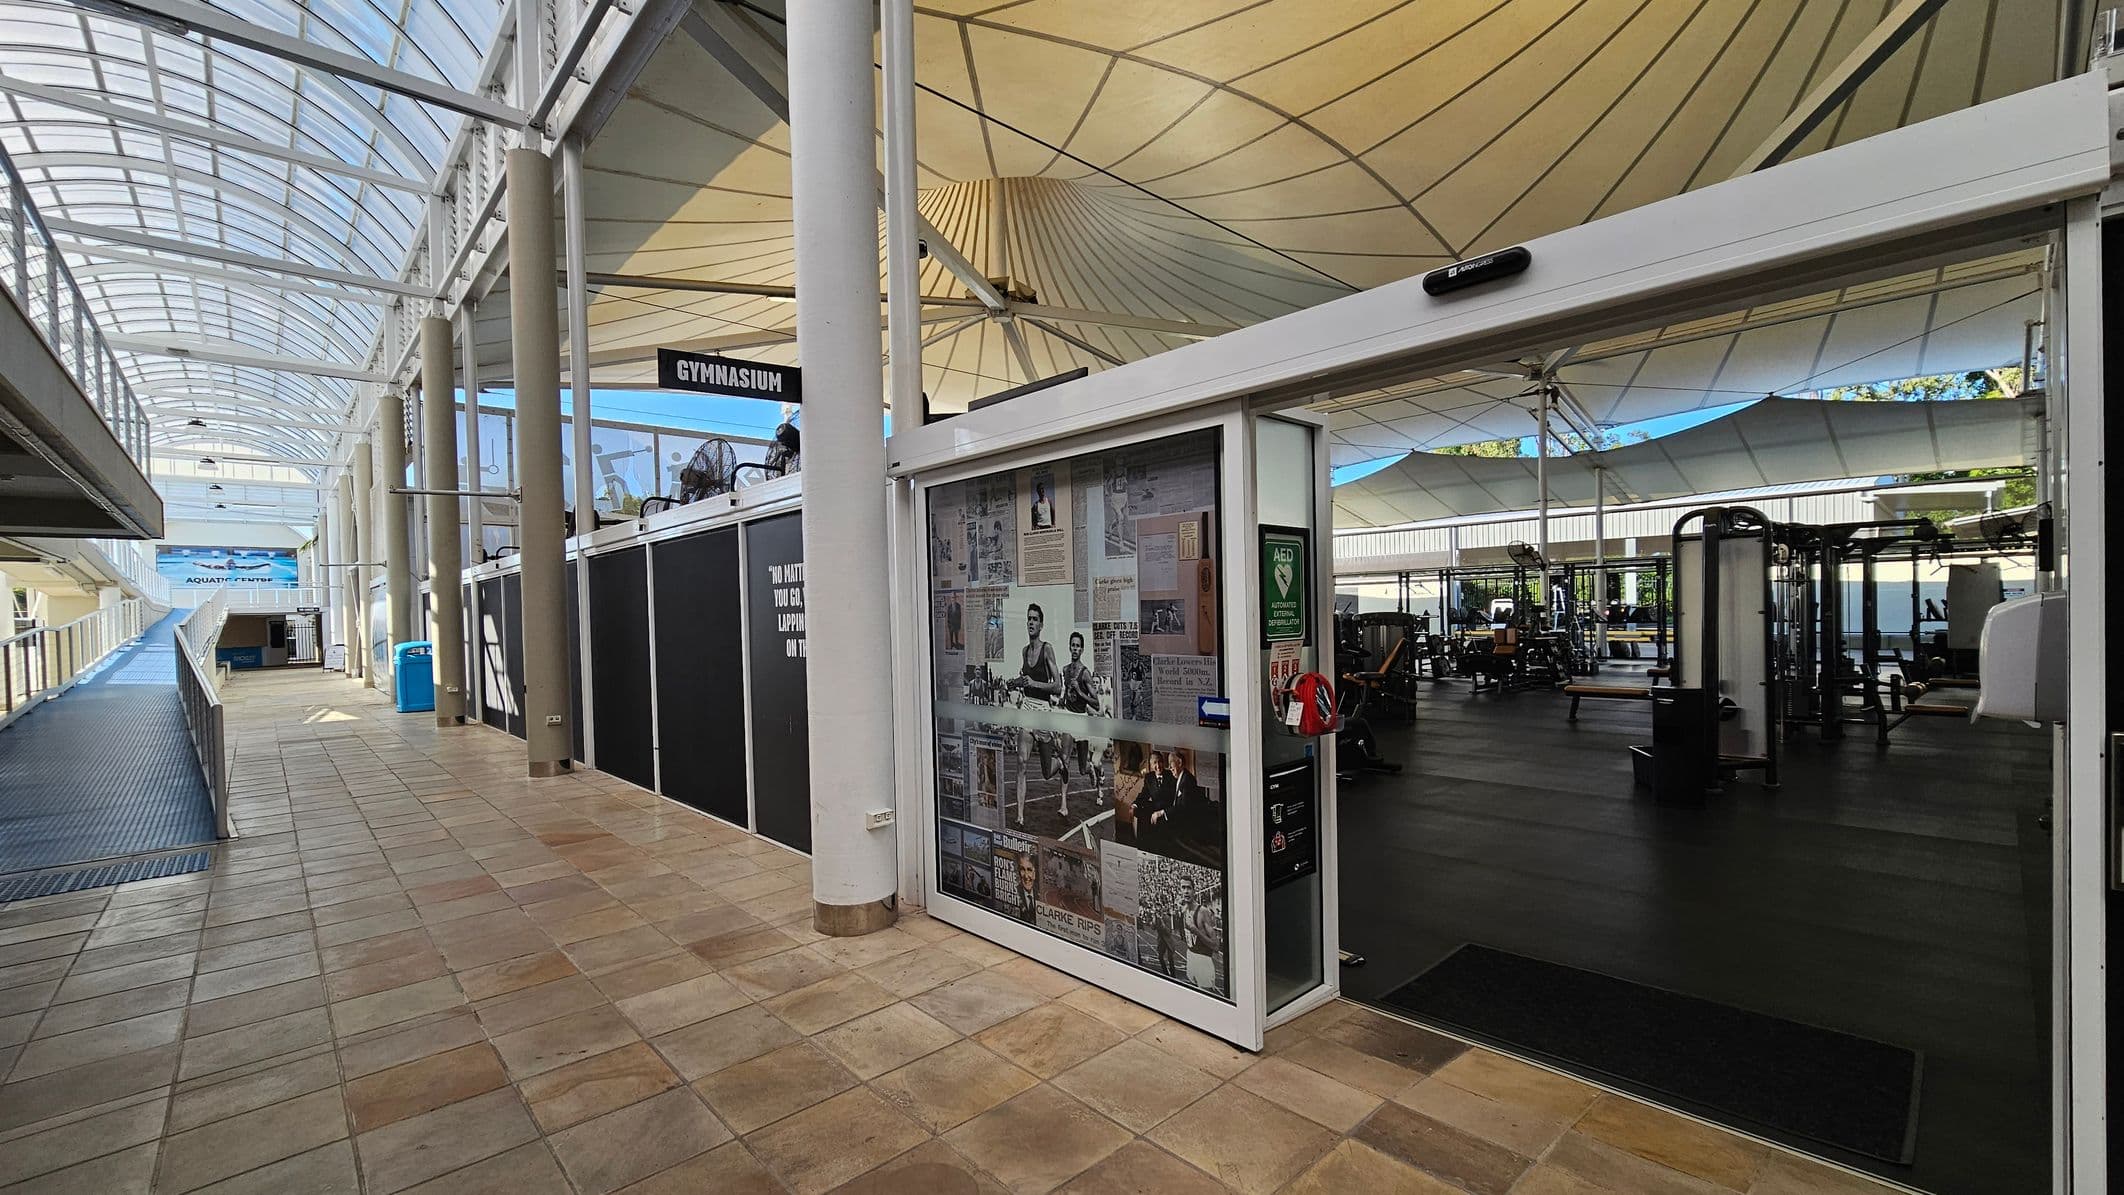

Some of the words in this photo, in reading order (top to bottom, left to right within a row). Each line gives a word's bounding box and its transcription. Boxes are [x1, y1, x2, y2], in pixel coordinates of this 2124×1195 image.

[676, 359, 782, 393] GYMNASIUM
[1273, 547, 1294, 562] AED
[784, 563, 805, 583] MATT
[773, 588, 789, 608] YOU
[790, 587, 803, 608] GO,
[1271, 601, 1297, 609] AUTOMATED
[1113, 622, 1127, 630] CUTS
[1268, 618, 1300, 627] DEFIBRILLATOR
[786, 638, 797, 658] ON
[1152, 656, 1175, 665] Clarke
[1176, 657, 1203, 666] Lowers
[1158, 666, 1180, 675] World
[1157, 676, 1182, 686] Record
[1185, 677, 1194, 686] in
[994, 855, 1015, 872] RON'S
[994, 866, 1017, 883] FLAME
[995, 877, 1018, 894] BURNS
[995, 888, 1020, 907] BRIGHT
[1036, 904, 1074, 926] CLARKE
[1077, 917, 1102, 936] RIPS
